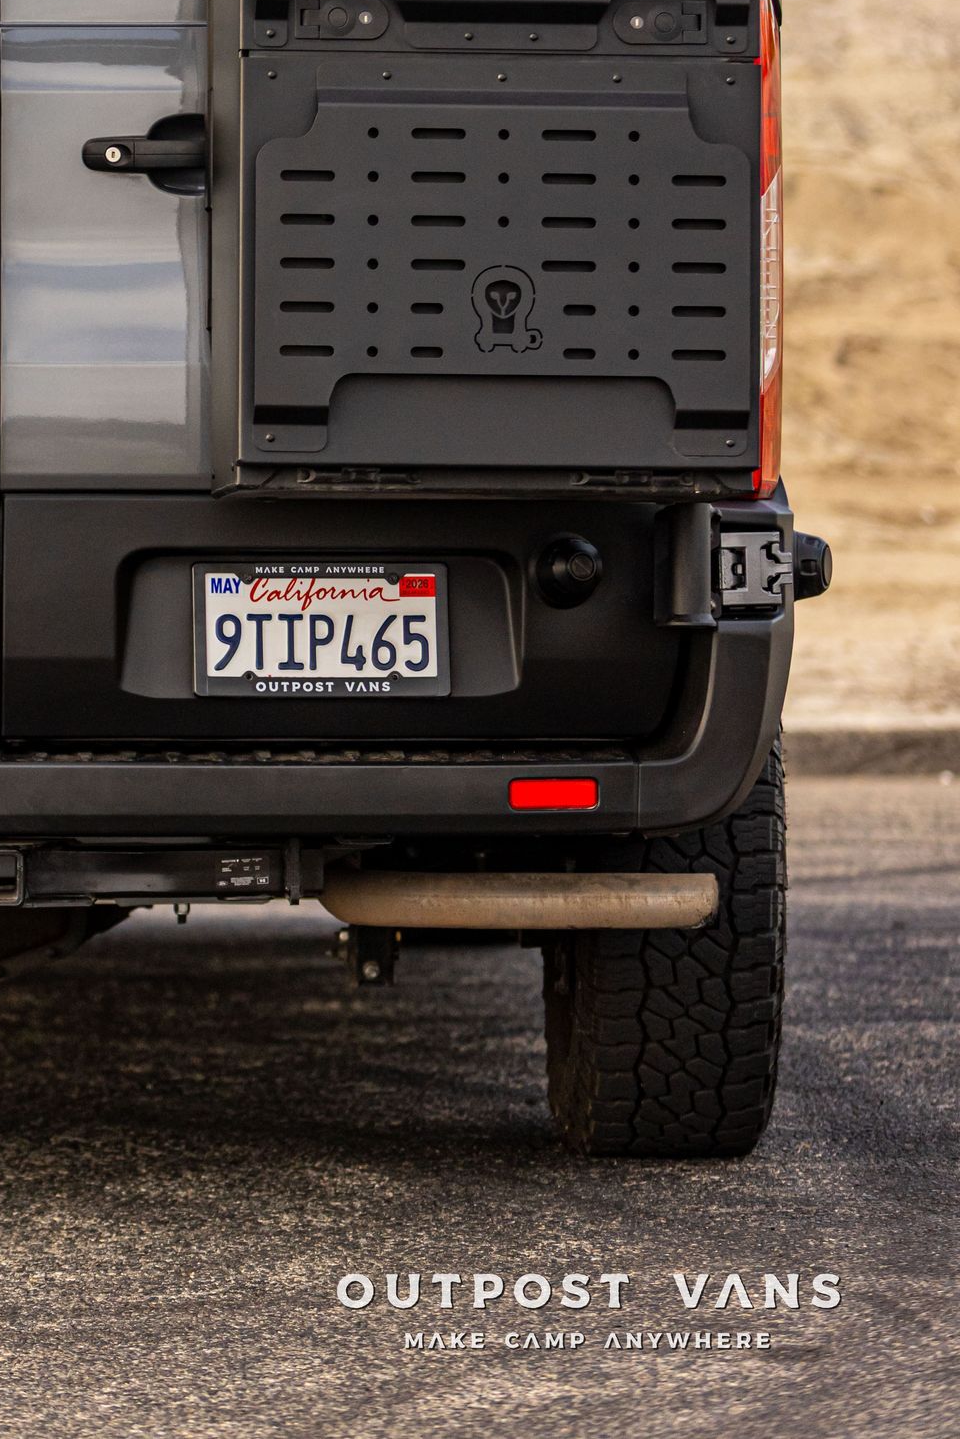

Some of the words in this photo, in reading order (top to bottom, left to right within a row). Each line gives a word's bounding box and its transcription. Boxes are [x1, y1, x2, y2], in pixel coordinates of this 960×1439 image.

[255, 566, 285, 574] MAKE
[290, 566, 320, 574] CAMP
[325, 566, 385, 574] ANYWHERE
[210, 577, 241, 594] MAY
[405, 578, 429, 589] 2026
[249, 577, 400, 611] California
[214, 614, 430, 672] 9TIP465
[255, 681, 334, 693] OUTPOST
[344, 681, 391, 693] VANS
